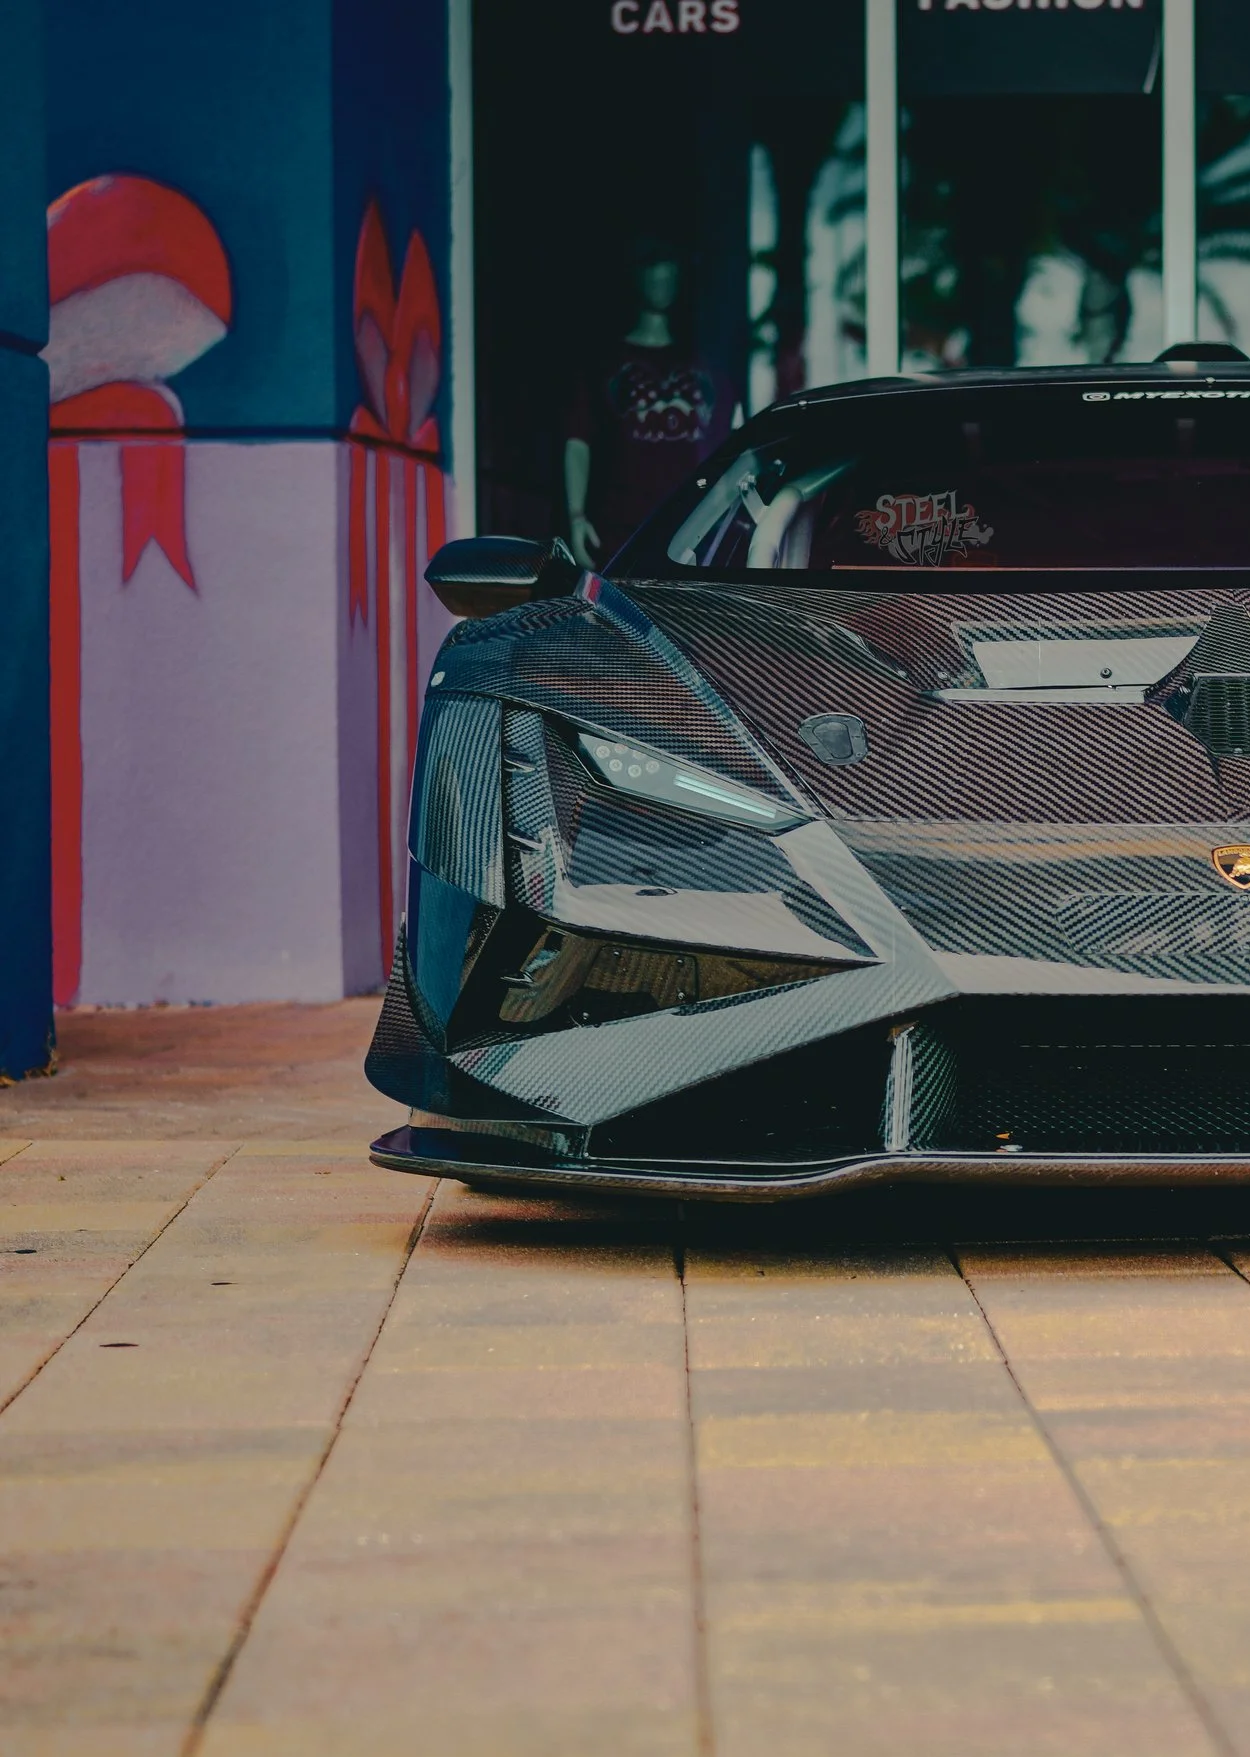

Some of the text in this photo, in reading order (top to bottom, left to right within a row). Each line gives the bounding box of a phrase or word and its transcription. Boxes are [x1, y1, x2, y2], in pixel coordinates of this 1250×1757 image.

[611, 0, 740, 33] CARS
[874, 488, 970, 531] STEEL
[879, 515, 980, 568] & STYLE
